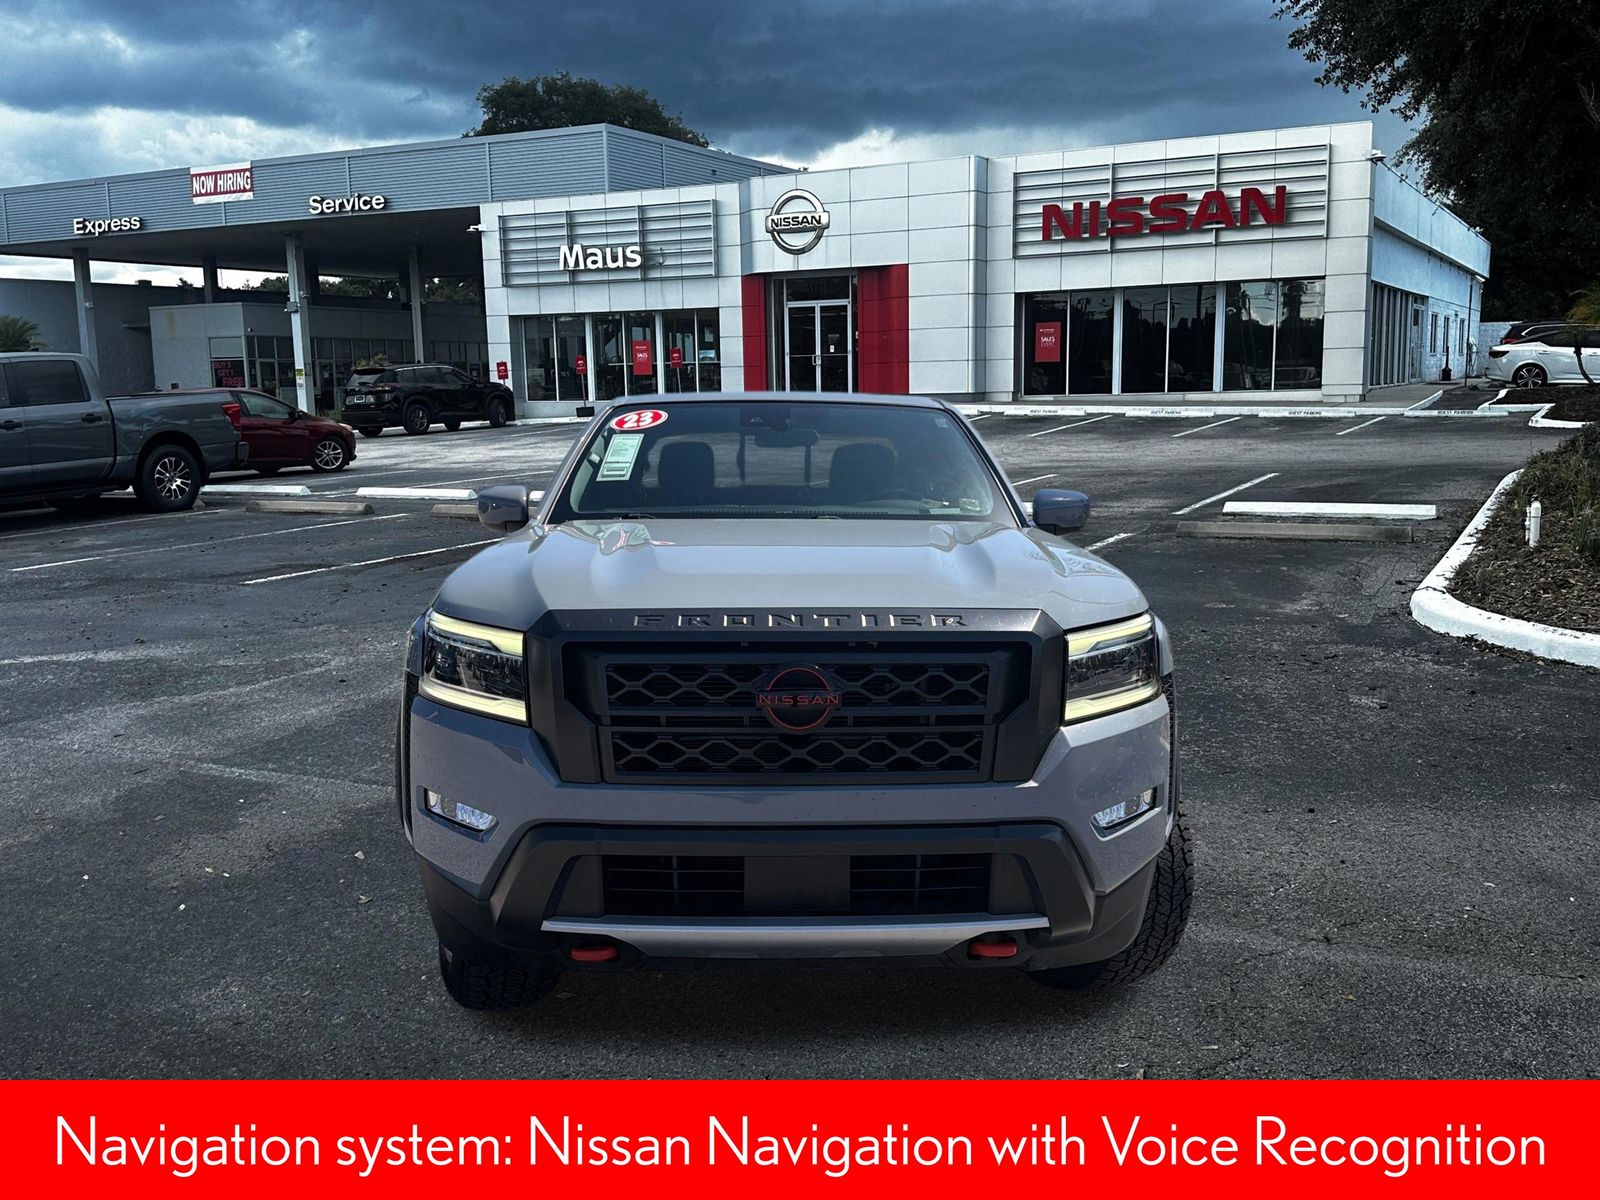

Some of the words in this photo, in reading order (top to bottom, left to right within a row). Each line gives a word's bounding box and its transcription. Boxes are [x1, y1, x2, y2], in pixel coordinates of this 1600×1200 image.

[192, 174, 216, 196] NOW
[217, 170, 252, 193] HIRING
[308, 193, 386, 216] Service
[1041, 185, 1288, 242] NISSAN
[73, 215, 142, 238] Express
[769, 213, 823, 230] NISSAN
[558, 243, 643, 272] Maus
[222, 377, 244, 386] FREE
[622, 411, 655, 429] 23
[633, 613, 969, 628] FRONTIER
[758, 694, 840, 706] NISSAN
